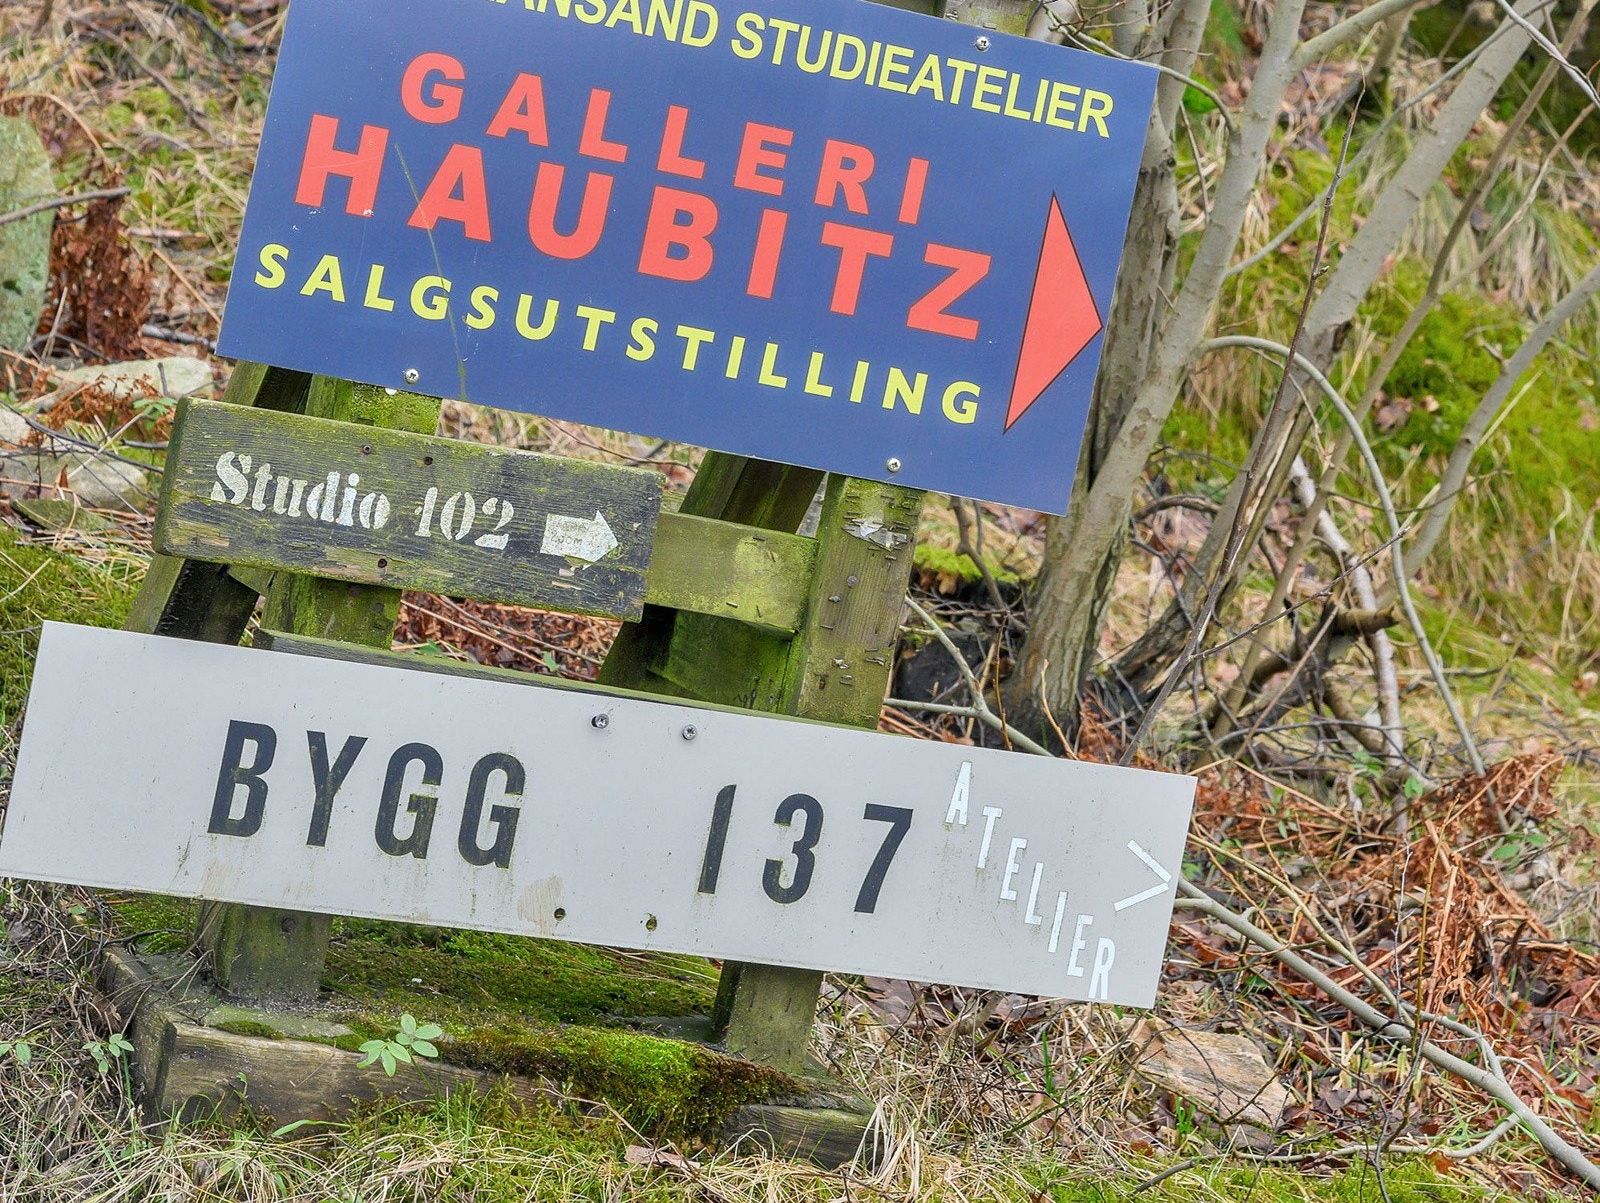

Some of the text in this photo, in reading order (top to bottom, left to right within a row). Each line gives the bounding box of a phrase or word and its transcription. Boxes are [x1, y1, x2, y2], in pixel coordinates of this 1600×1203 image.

[401, 53, 929, 225] GALLERI
[730, 12, 1113, 138] STUDIEATELIER
[295, 114, 991, 340] HAUBITZ
[254, 243, 980, 425] SALGSUTSTILLING
[210, 451, 515, 550] Studio 102
[206, 719, 913, 914] BYGG 137
[945, 760, 1116, 1000] ATELIER
